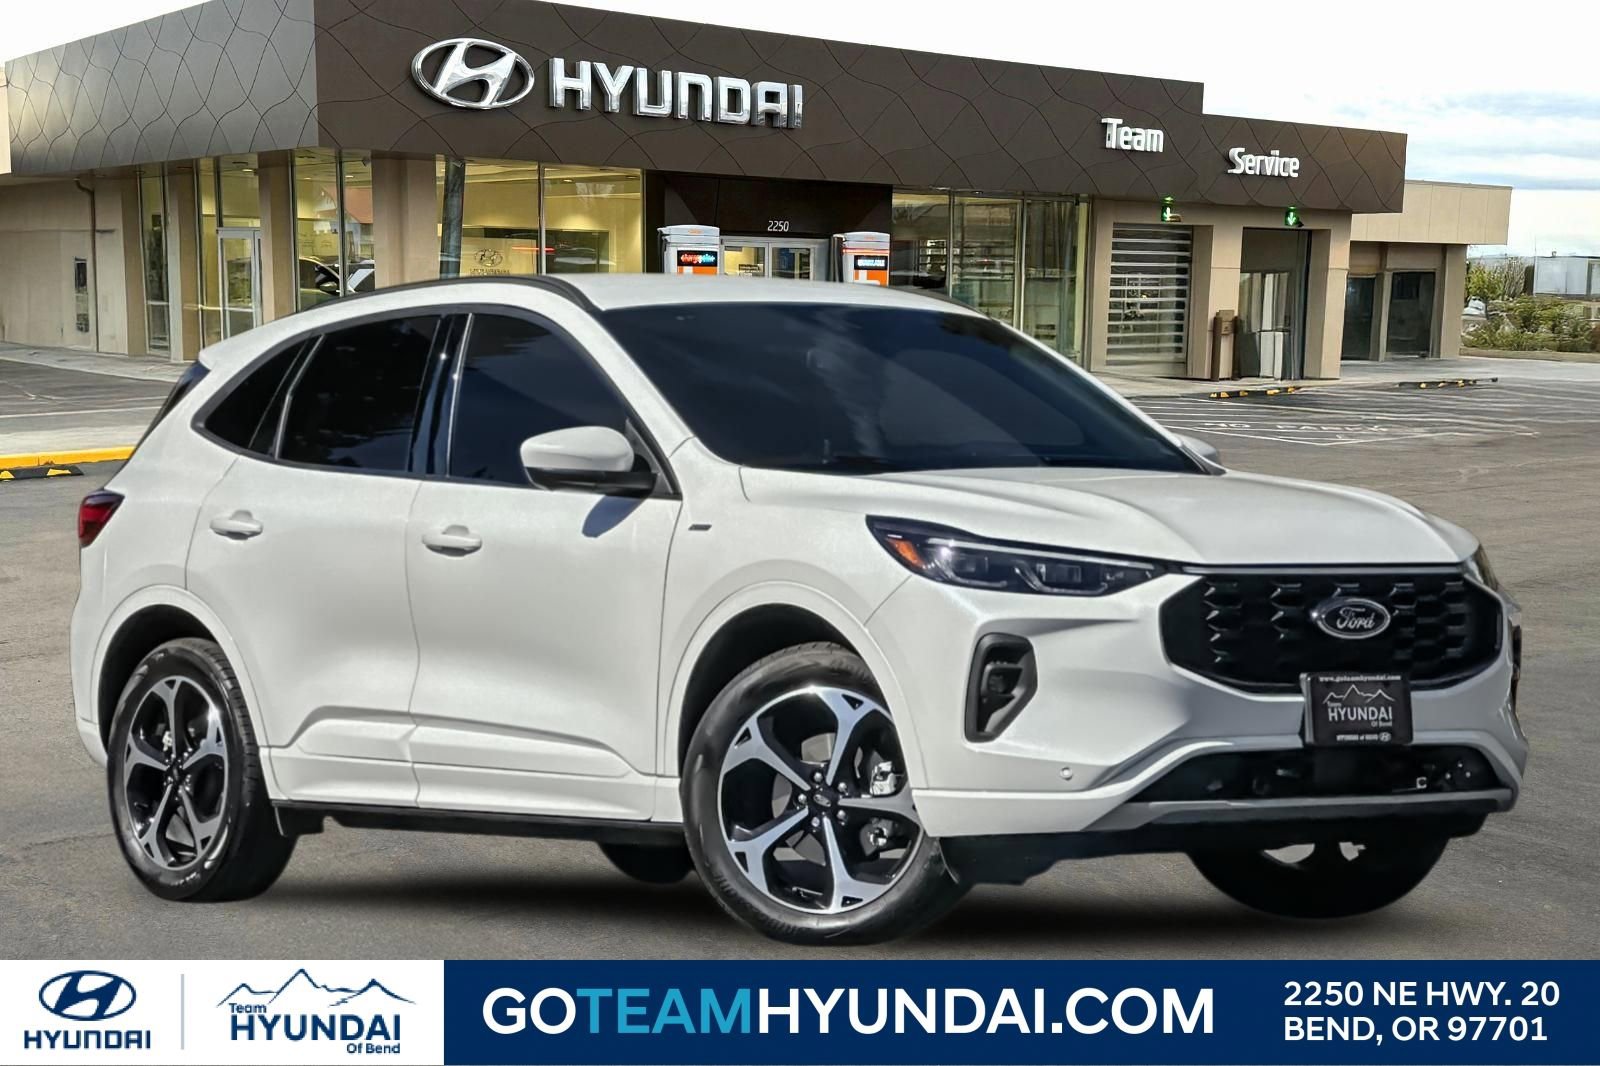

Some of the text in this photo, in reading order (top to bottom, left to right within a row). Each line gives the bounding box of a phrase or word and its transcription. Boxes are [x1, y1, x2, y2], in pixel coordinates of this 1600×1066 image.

[548, 56, 804, 129] HYUNDAI
[1101, 117, 1164, 153] Team
[1227, 147, 1300, 178] Service
[767, 220, 790, 232] 2250
[1336, 607, 1375, 629] Ford
[1327, 706, 1393, 722] HYUNDAI
